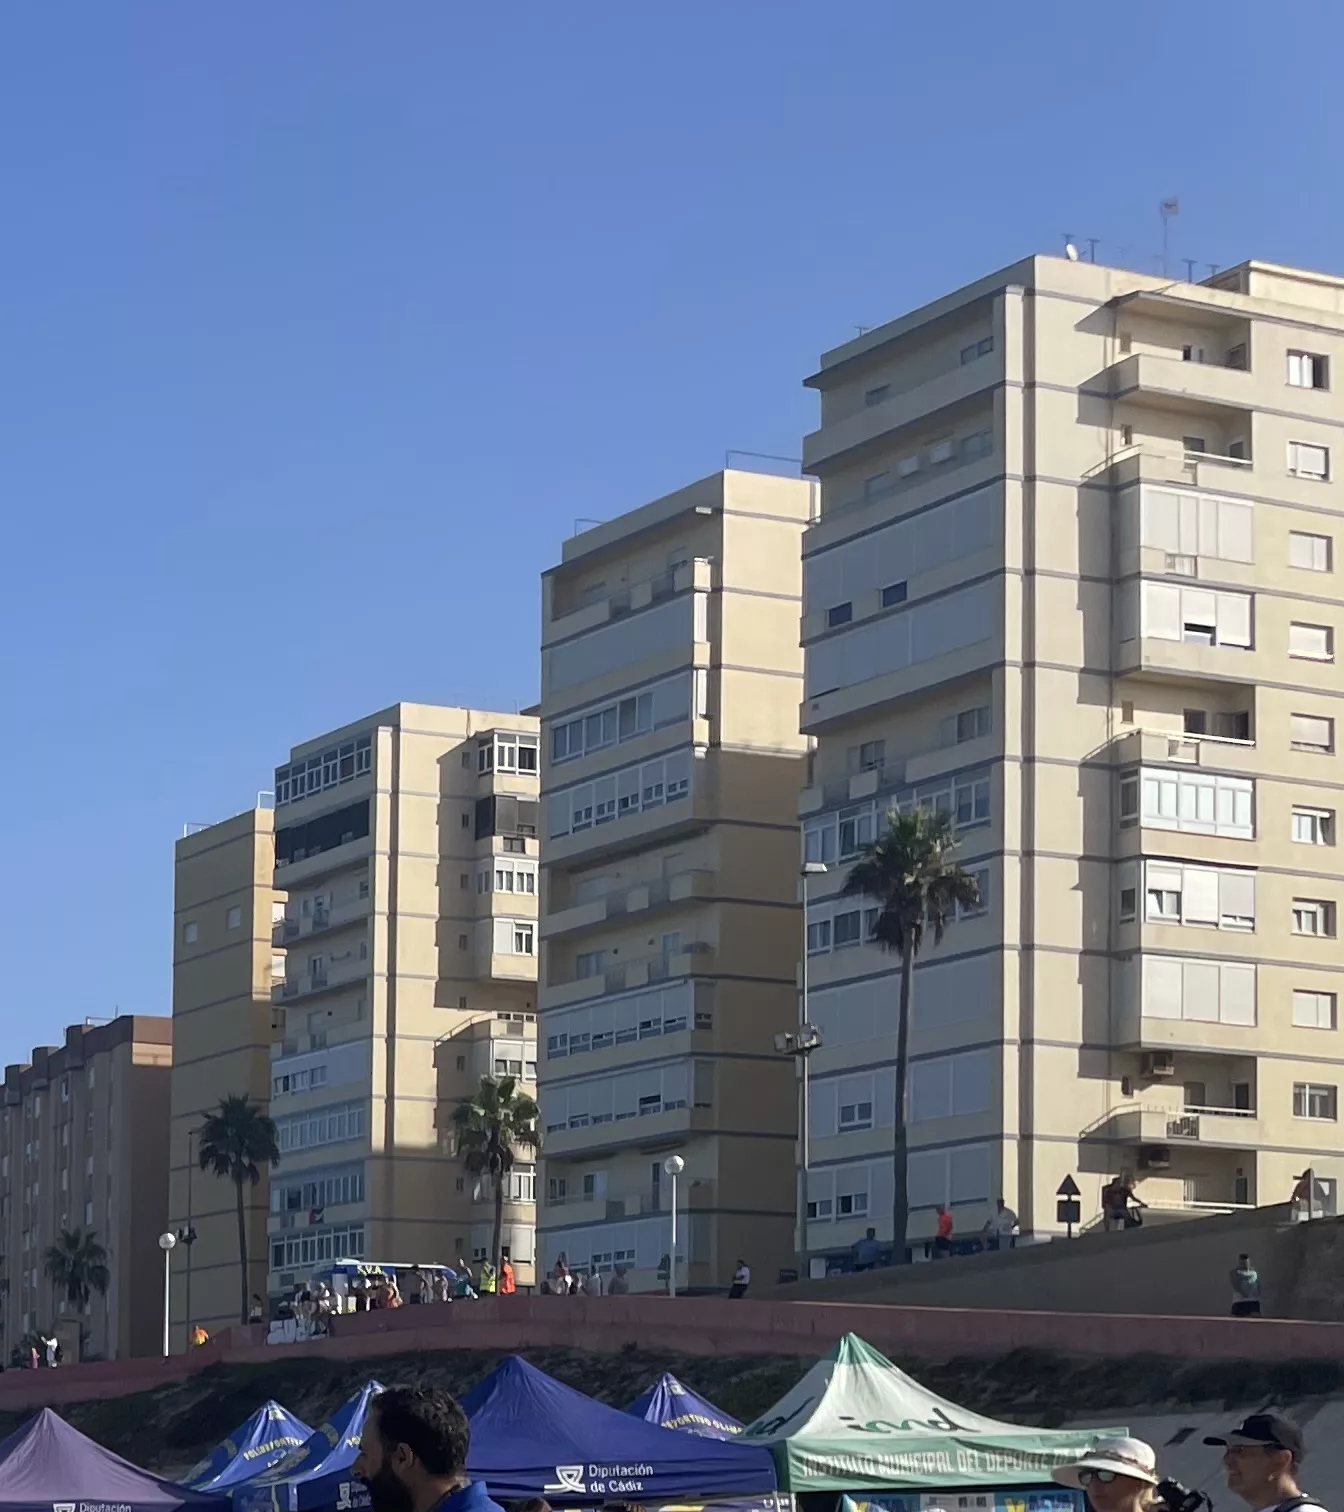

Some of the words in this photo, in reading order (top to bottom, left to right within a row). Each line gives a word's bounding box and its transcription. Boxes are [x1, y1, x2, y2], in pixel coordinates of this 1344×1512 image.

[877, 1450, 955, 1475] MUNICIPAL
[956, 1449, 982, 1473] DEL
[589, 1464, 654, 1479] Diputación
[590, 1481, 606, 1493] de
[609, 1480, 644, 1493] Cádiz
